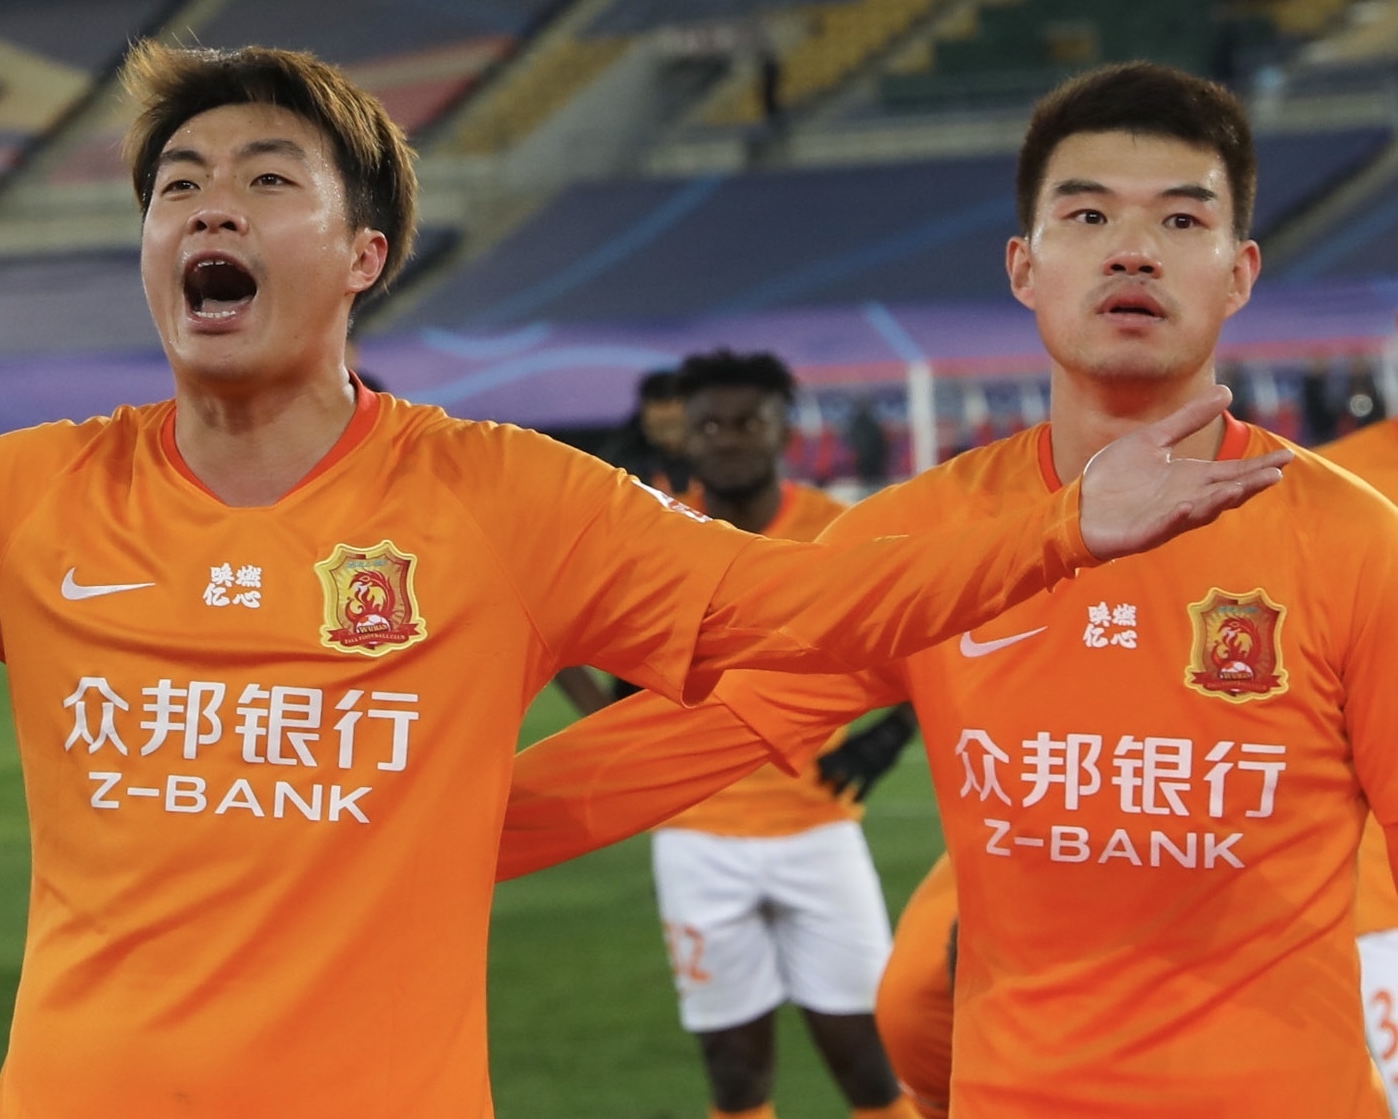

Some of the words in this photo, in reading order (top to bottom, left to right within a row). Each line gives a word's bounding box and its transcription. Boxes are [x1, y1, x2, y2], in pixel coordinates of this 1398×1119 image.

[63, 676, 420, 772] 众邦银行
[88, 771, 373, 824] Z-BANK
[955, 728, 1287, 819] 众邦银行
[984, 819, 1247, 870] Z-BANK
